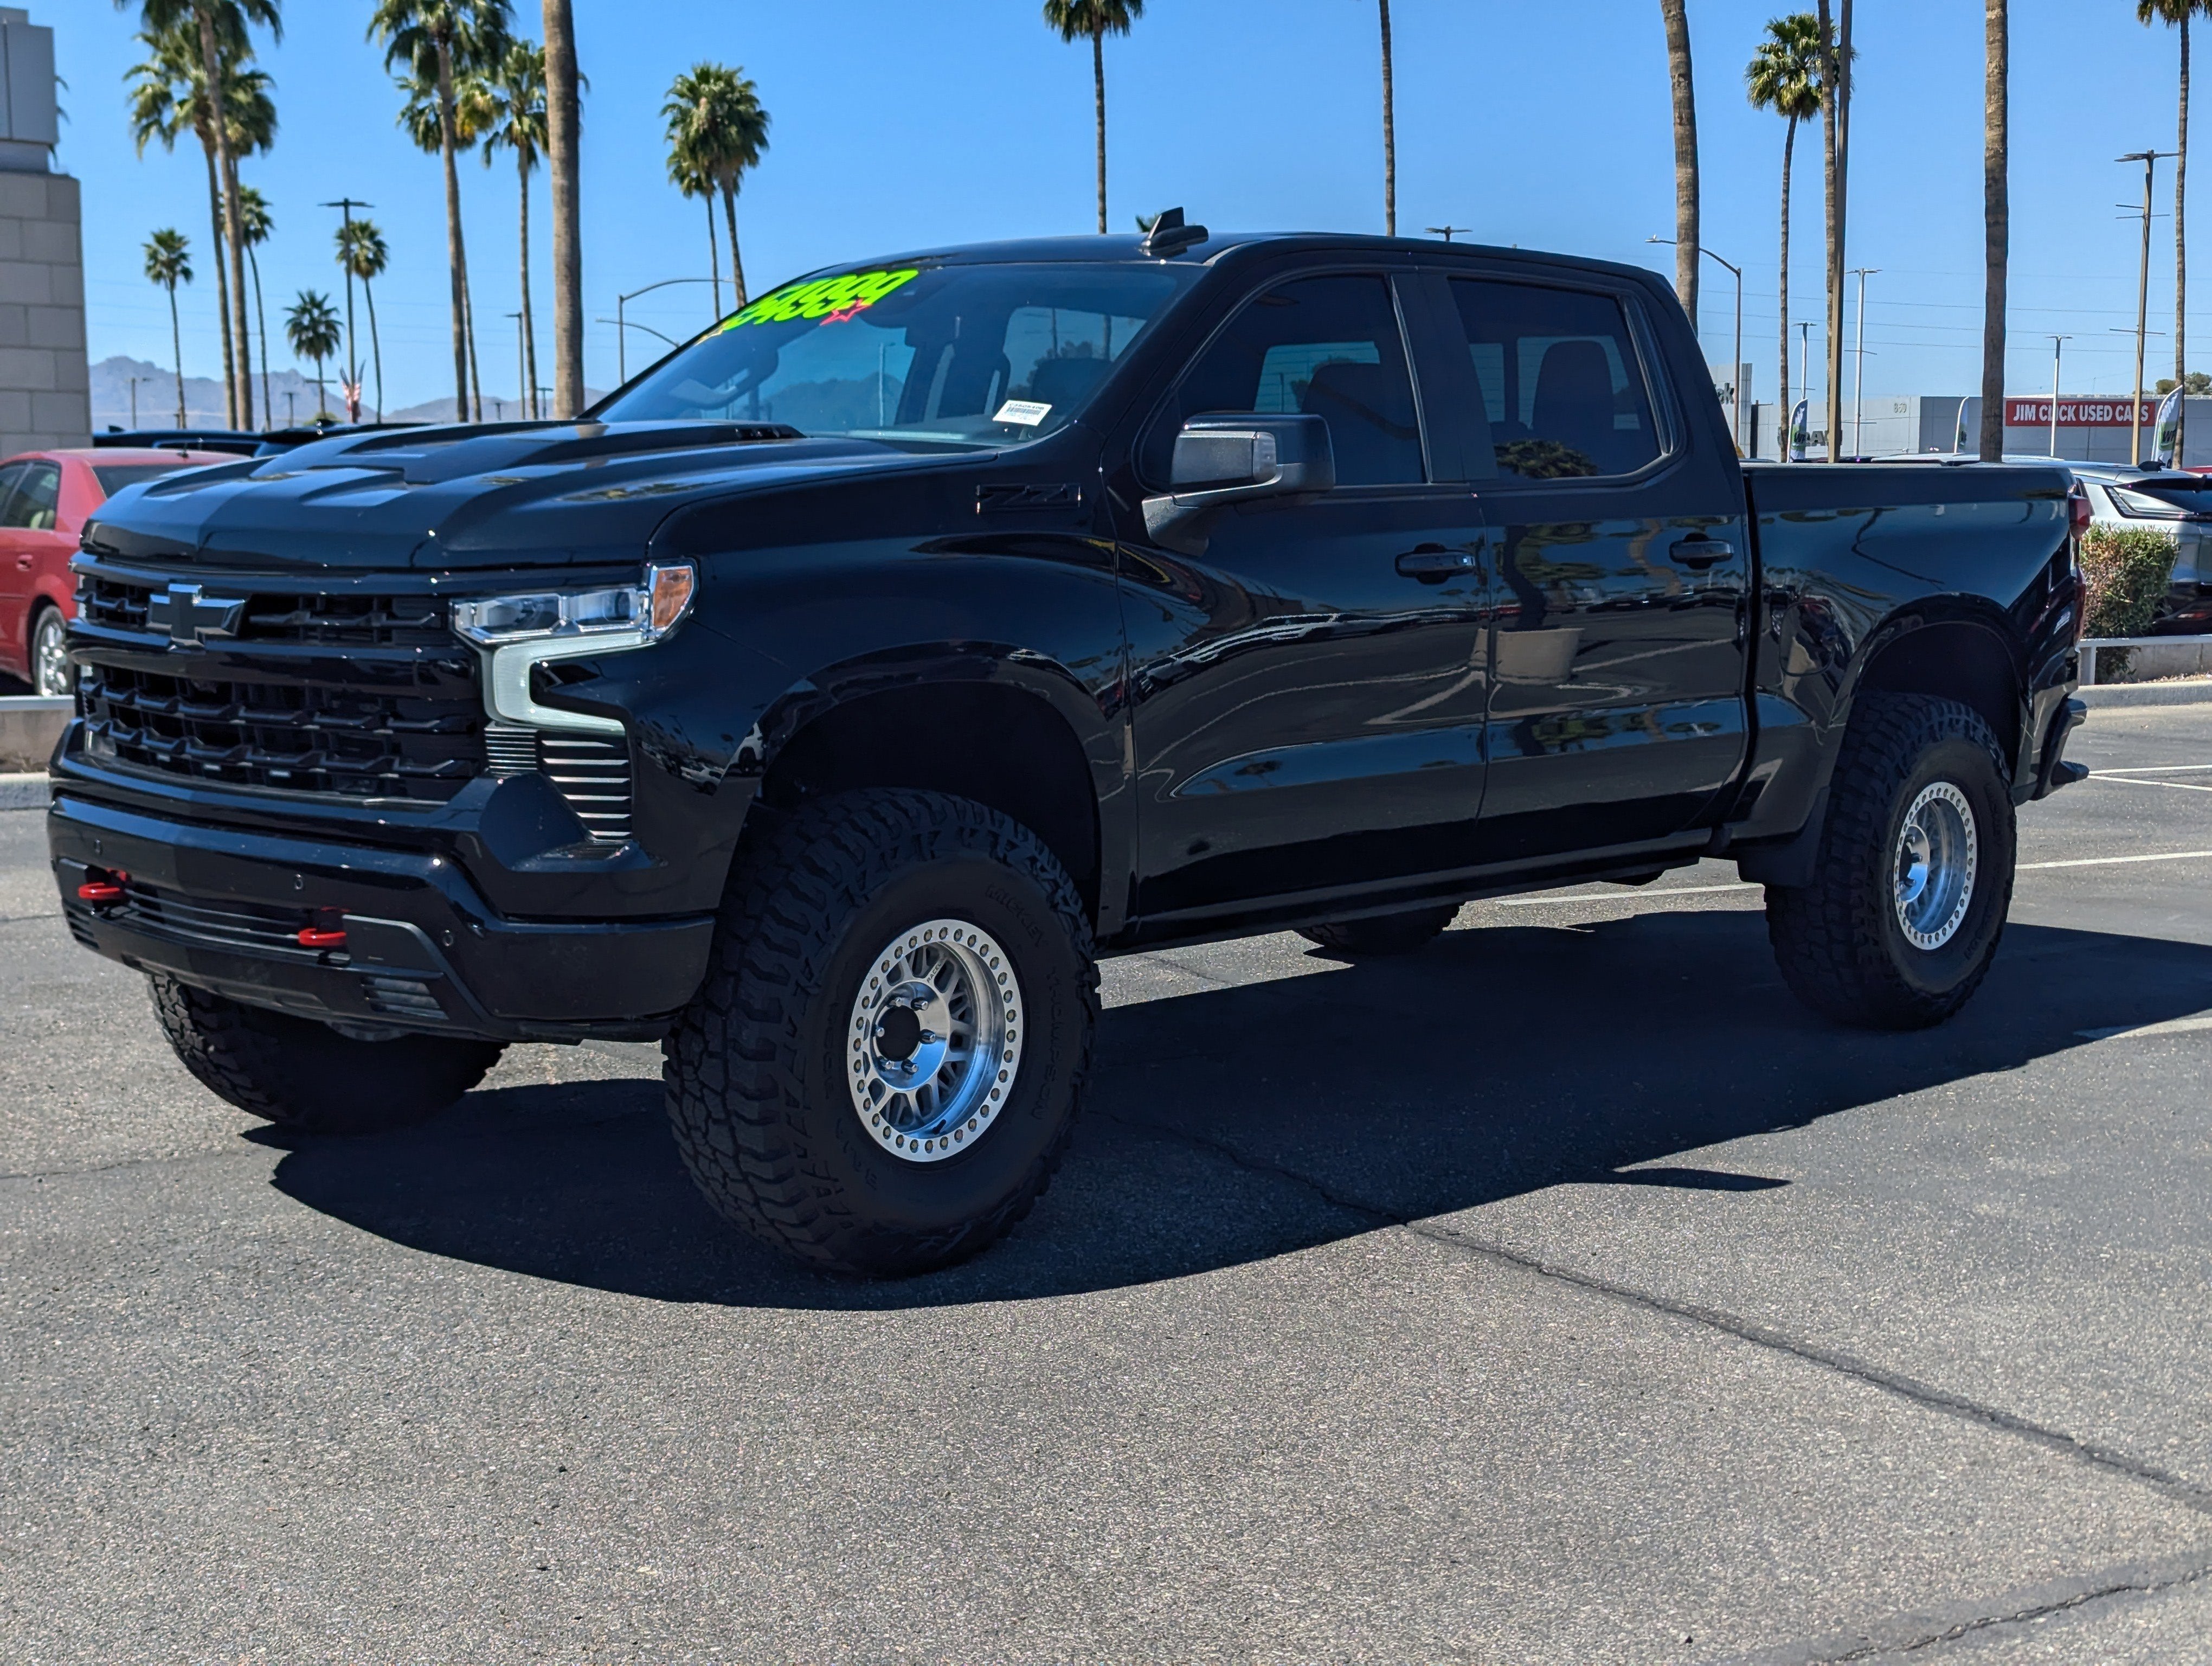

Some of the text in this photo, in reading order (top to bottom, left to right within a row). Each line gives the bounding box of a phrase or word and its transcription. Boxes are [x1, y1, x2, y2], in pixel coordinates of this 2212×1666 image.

[2013, 405, 2036, 421] JIM
[2079, 405, 2113, 421] USED
[2115, 405, 2149, 422] CAS
